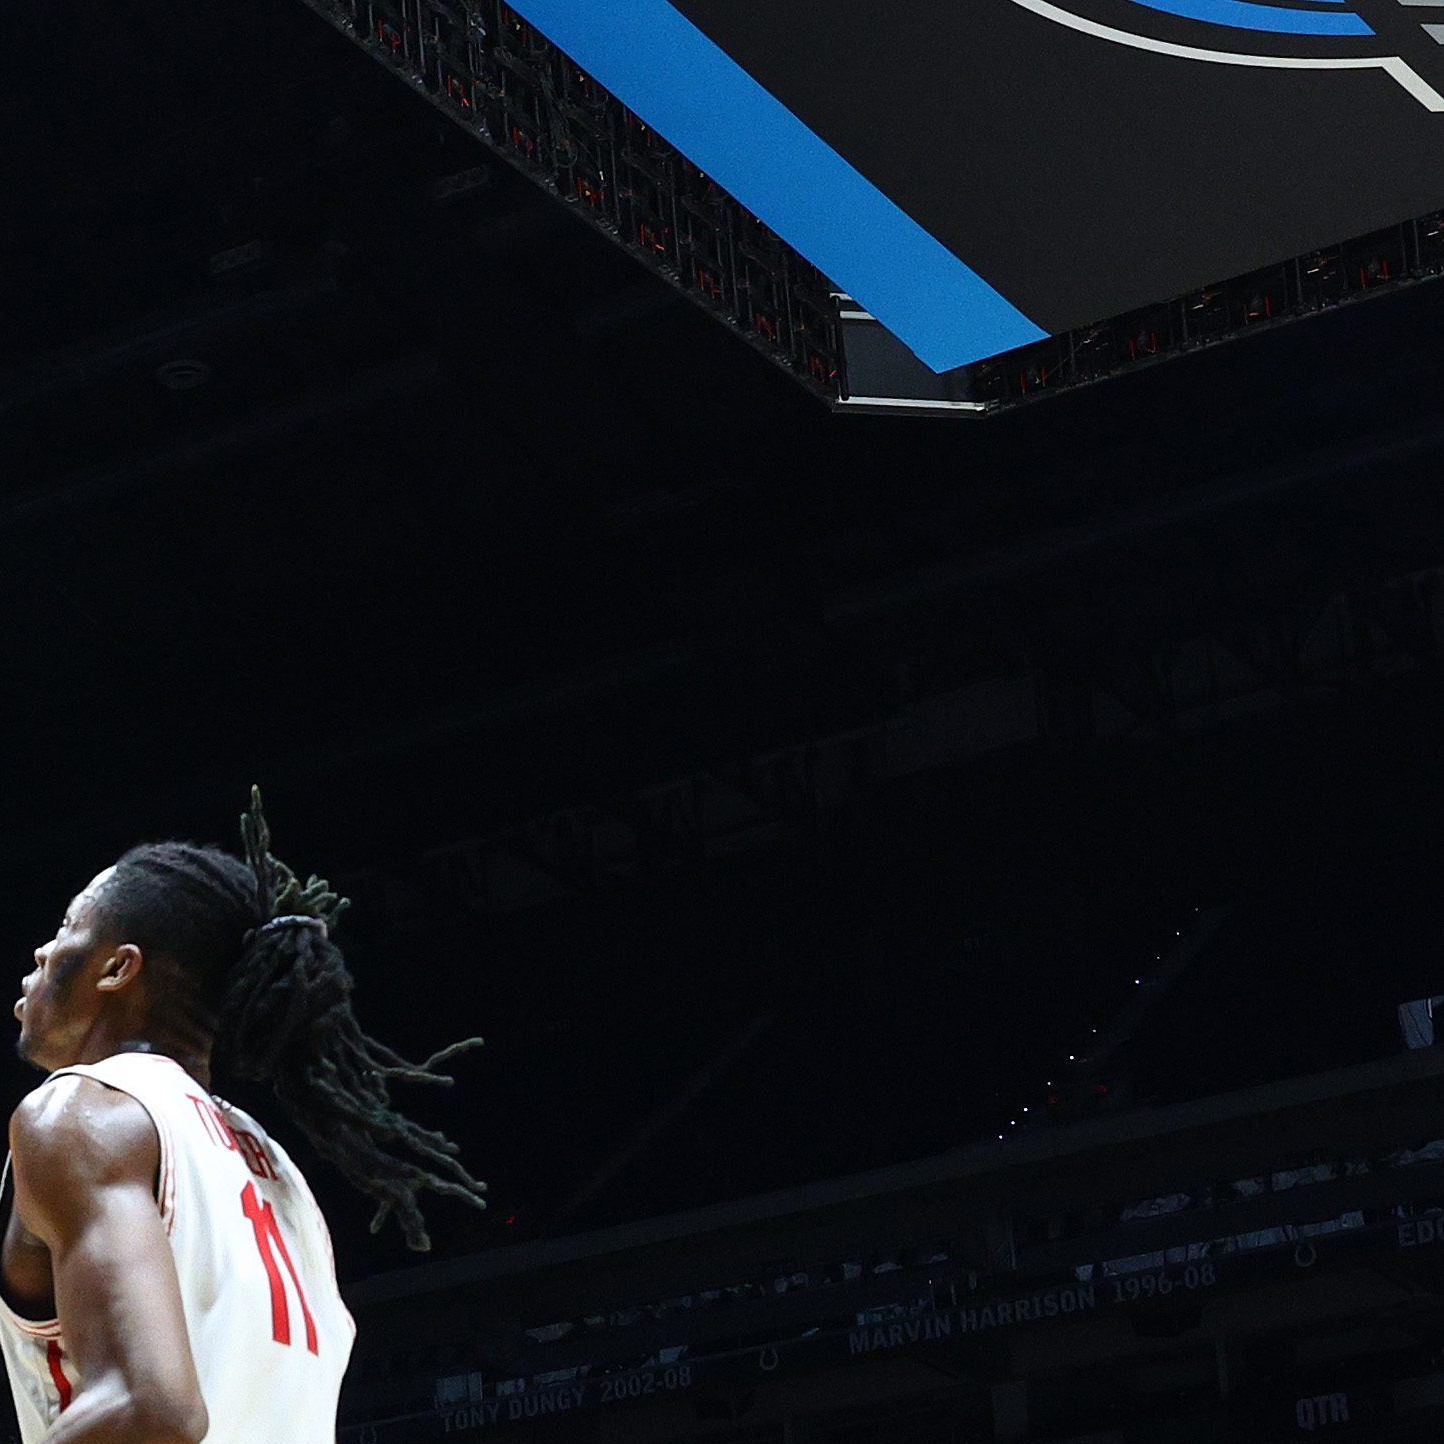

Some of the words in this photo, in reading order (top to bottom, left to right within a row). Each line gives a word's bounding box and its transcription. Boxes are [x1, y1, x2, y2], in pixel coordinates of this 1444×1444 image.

[240, 1180, 319, 1357] 11
[847, 1313, 952, 1355] MARVIN
[959, 1284, 1097, 1333] HARRISON
[1112, 1261, 1218, 1304] 1996-08
[439, 1402, 501, 1433] TONY
[507, 1384, 587, 1422] DUNGY
[599, 1364, 694, 1405] 2002-08
